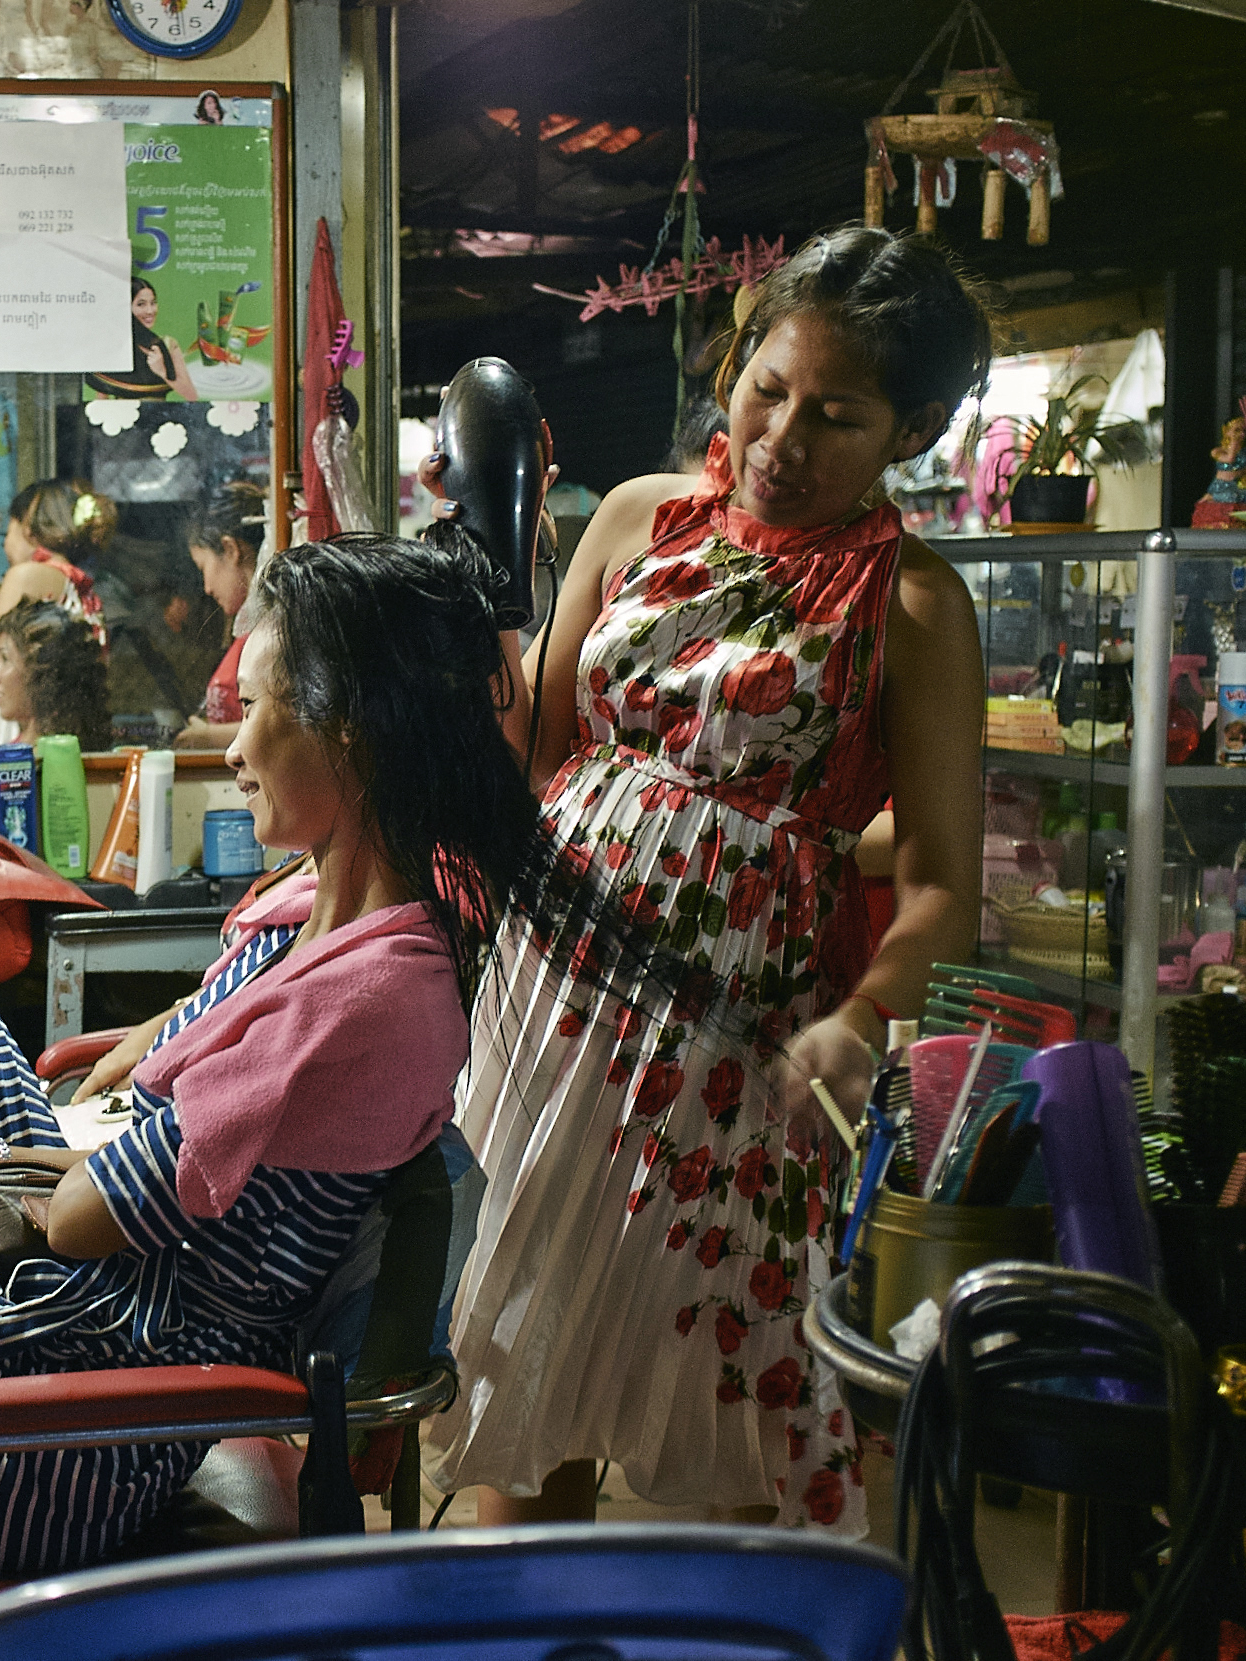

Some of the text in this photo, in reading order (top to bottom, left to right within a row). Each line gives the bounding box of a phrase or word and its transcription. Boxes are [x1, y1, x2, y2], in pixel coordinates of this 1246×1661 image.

[134, 2, 144, 14] 8
[203, 0, 215, 10] 4
[148, 17, 159, 29] 7
[189, 16, 201, 28] 5
[168, 24, 181, 36] 6
[125, 138, 182, 167] joice
[18, 210, 35, 220] 092
[38, 210, 54, 220] 132
[57, 210, 74, 220] 732
[38, 223, 54, 233] 221
[133, 205, 171, 272] 5
